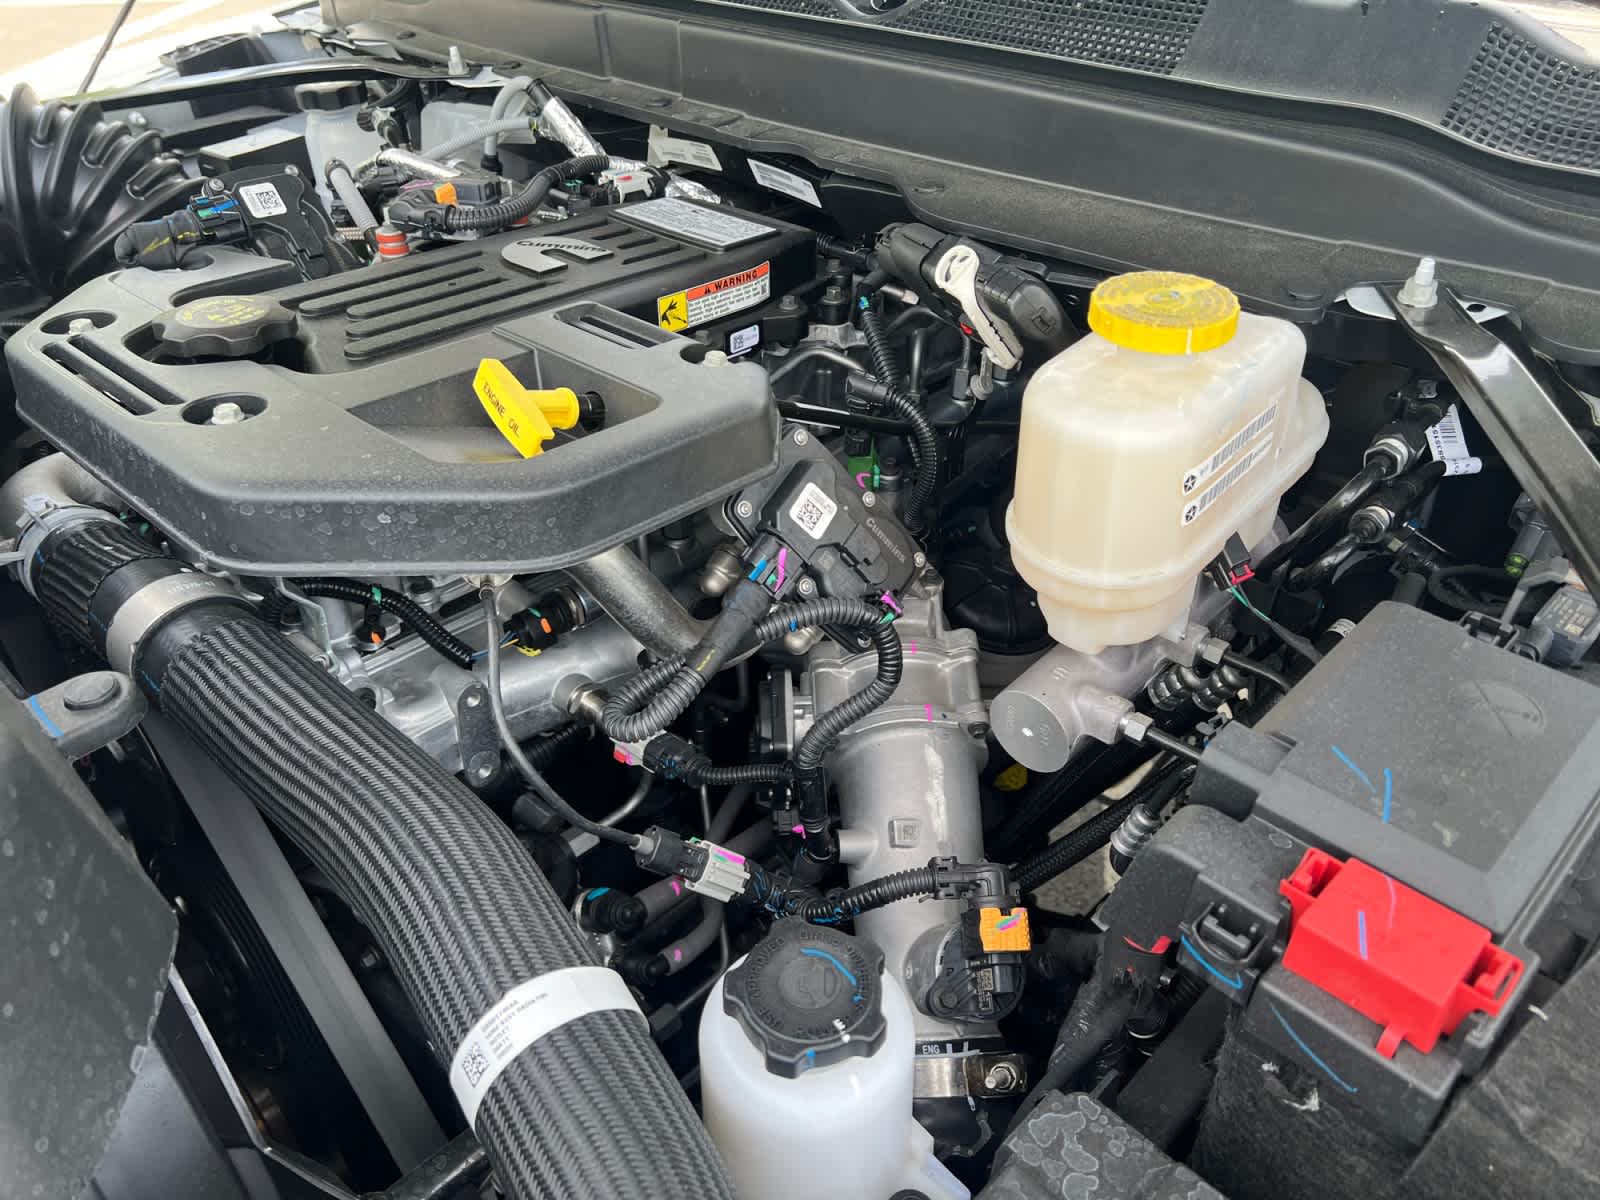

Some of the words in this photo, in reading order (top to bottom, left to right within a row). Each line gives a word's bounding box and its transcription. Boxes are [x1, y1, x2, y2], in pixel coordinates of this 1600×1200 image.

[516, 240, 608, 253] Cummins
[714, 269, 758, 291] WARNING
[483, 381, 506, 418] ENGINE
[508, 418, 520, 438] OIL
[866, 518, 905, 563] Cummins
[922, 1043, 940, 1055] ENG
